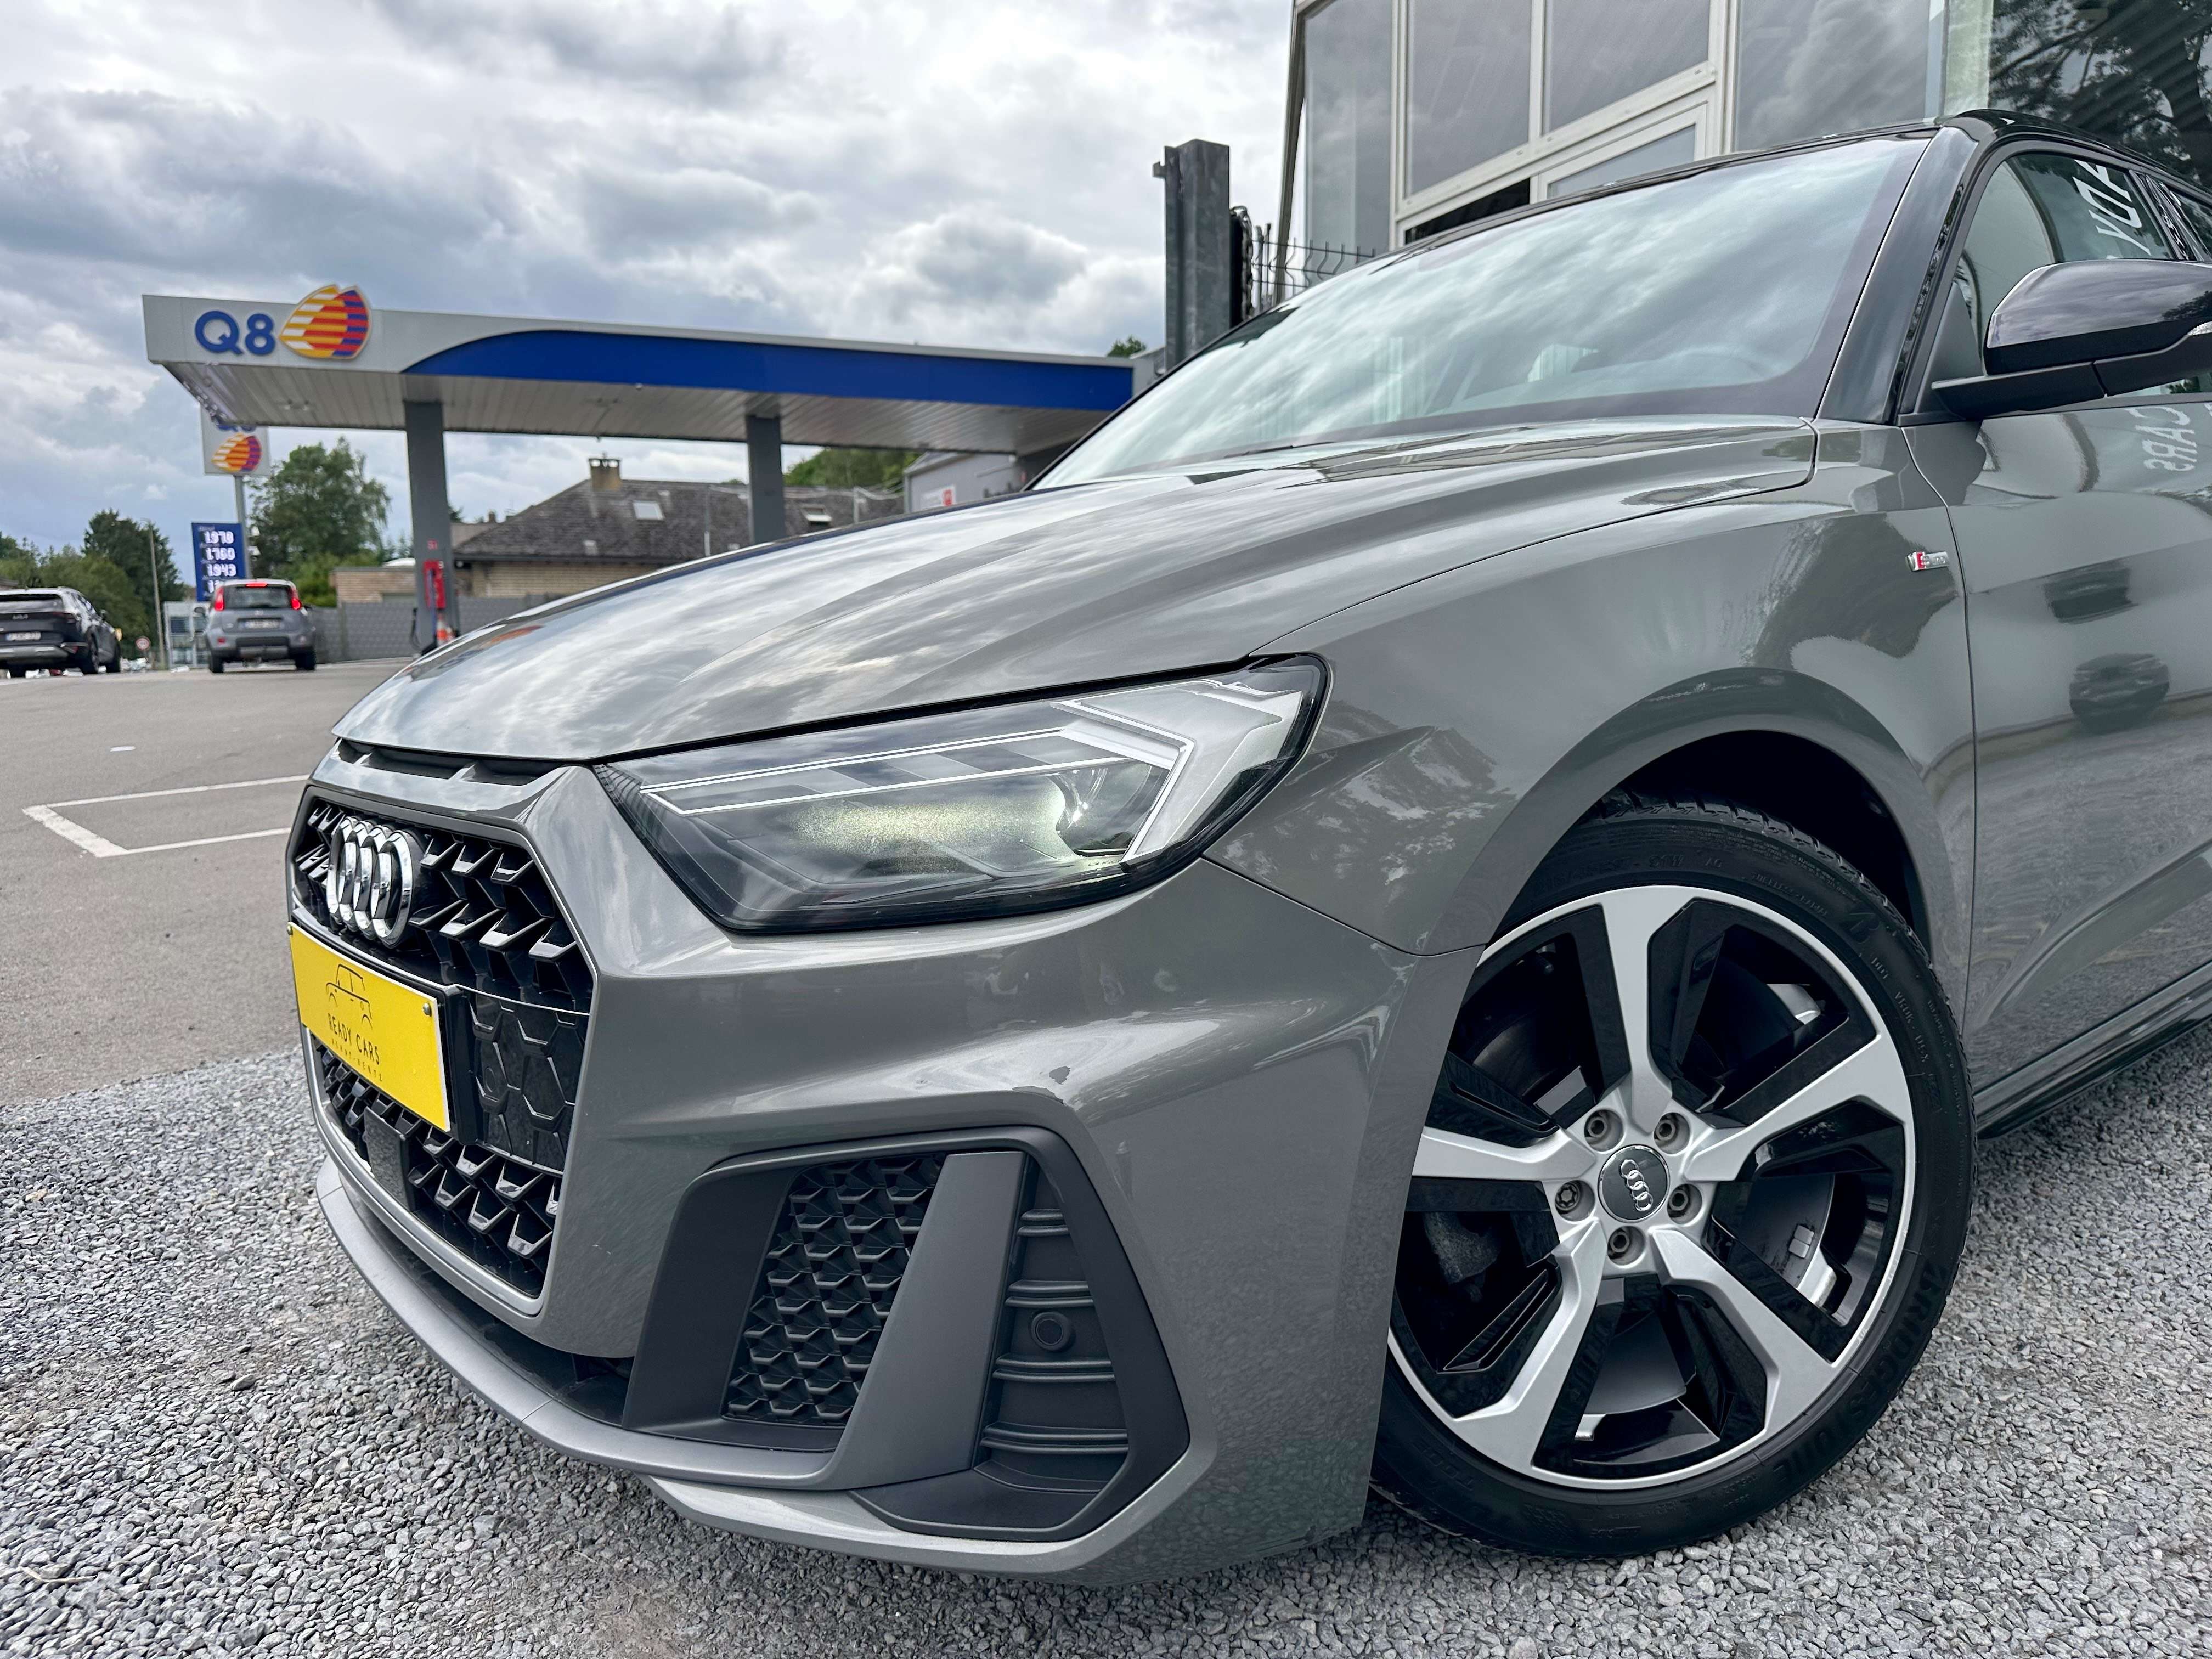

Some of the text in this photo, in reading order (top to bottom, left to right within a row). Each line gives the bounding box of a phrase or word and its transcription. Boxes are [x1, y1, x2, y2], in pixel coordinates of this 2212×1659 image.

[195, 311, 276, 356] Q8
[328, 1013, 380, 1065] READY CARS
[1768, 1259, 1949, 1493] BRIDGESTONE
